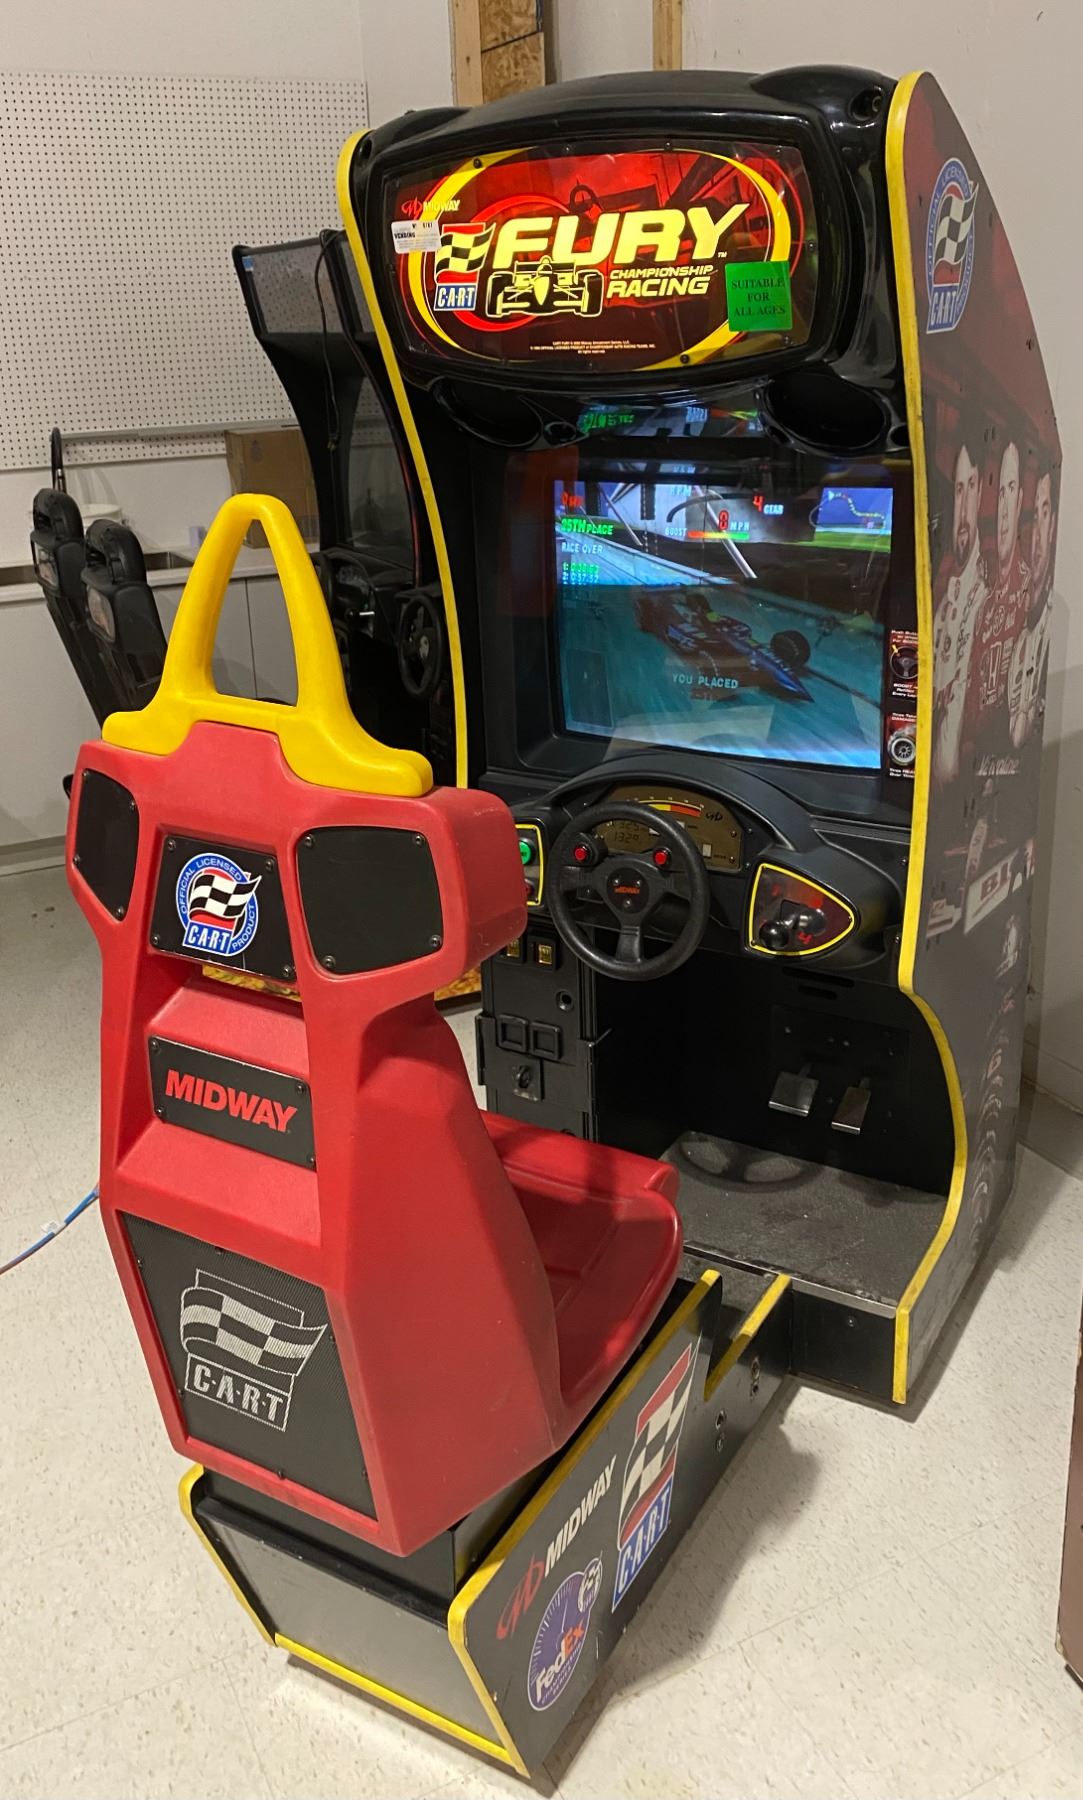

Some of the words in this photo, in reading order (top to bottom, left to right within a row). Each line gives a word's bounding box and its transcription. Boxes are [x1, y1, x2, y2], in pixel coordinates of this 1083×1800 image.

[423, 200, 460, 212] MIDWAY
[492, 203, 750, 269] FURY
[610, 265, 713, 279] CHAMPIONSHIP
[606, 277, 710, 298] RACING
[731, 278, 785, 289] SUITABLE
[747, 293, 769, 303] FOR
[734, 306, 753, 317] ALL
[757, 305, 786, 315] AGES
[752, 495, 764, 512] 4
[764, 504, 784, 515] GEAR
[586, 523, 614, 535] PLACE
[730, 521, 750, 531] MPH
[561, 541, 579, 553] RACE
[582, 544, 603, 554] OVER
[672, 673, 693, 684] YOU
[697, 675, 739, 689] PLACED
[180, 866, 196, 914] OFFICIAL
[195, 857, 242, 881] LICENSED
[231, 903, 255, 950] PRODUCT
[165, 1069, 298, 1133] MIDWAY
[544, 1454, 617, 1579] MIDWAY
[535, 1617, 585, 1704] FedEx
